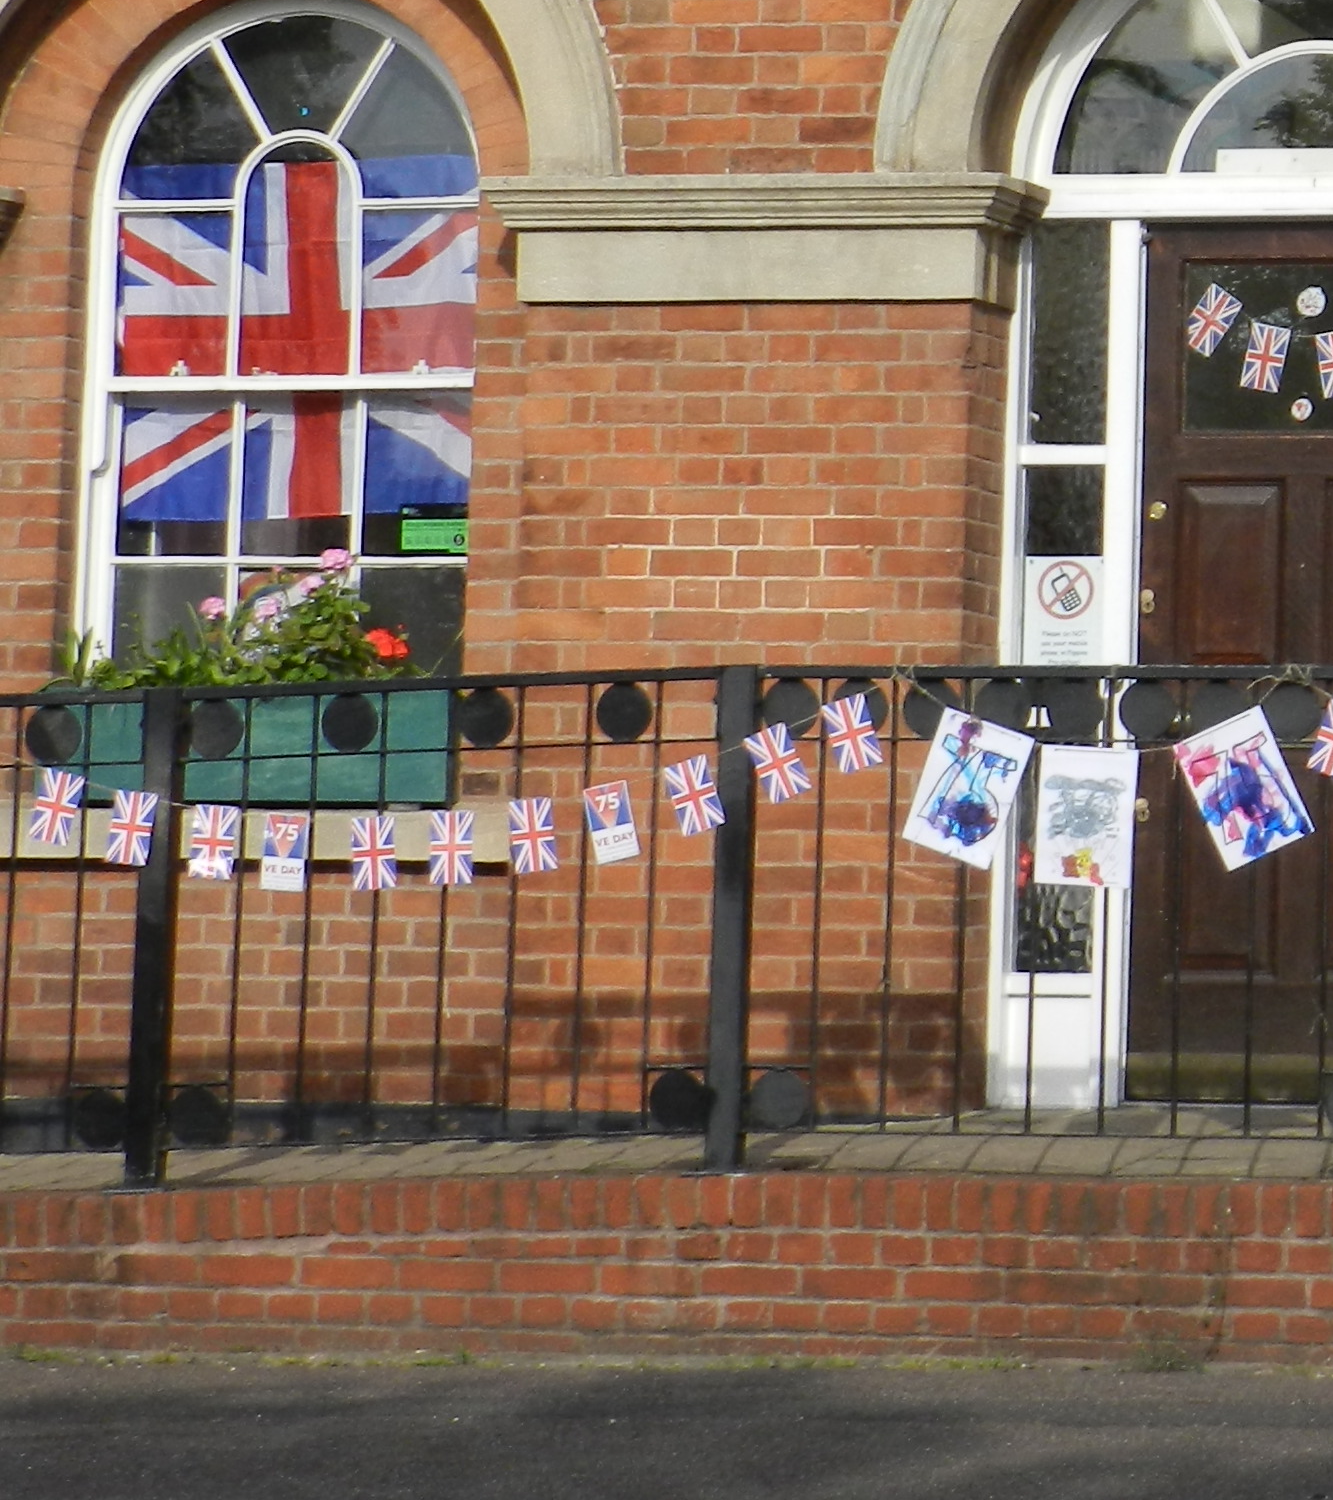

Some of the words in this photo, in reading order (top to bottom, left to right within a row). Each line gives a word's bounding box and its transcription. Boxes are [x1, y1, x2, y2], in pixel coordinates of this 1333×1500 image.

[595, 792, 620, 813] 75
[275, 823, 299, 841] 75
[595, 837, 610, 847] VE
[612, 831, 634, 843] DAY
[264, 864, 277, 873] VE
[281, 865, 303, 875] DAY
